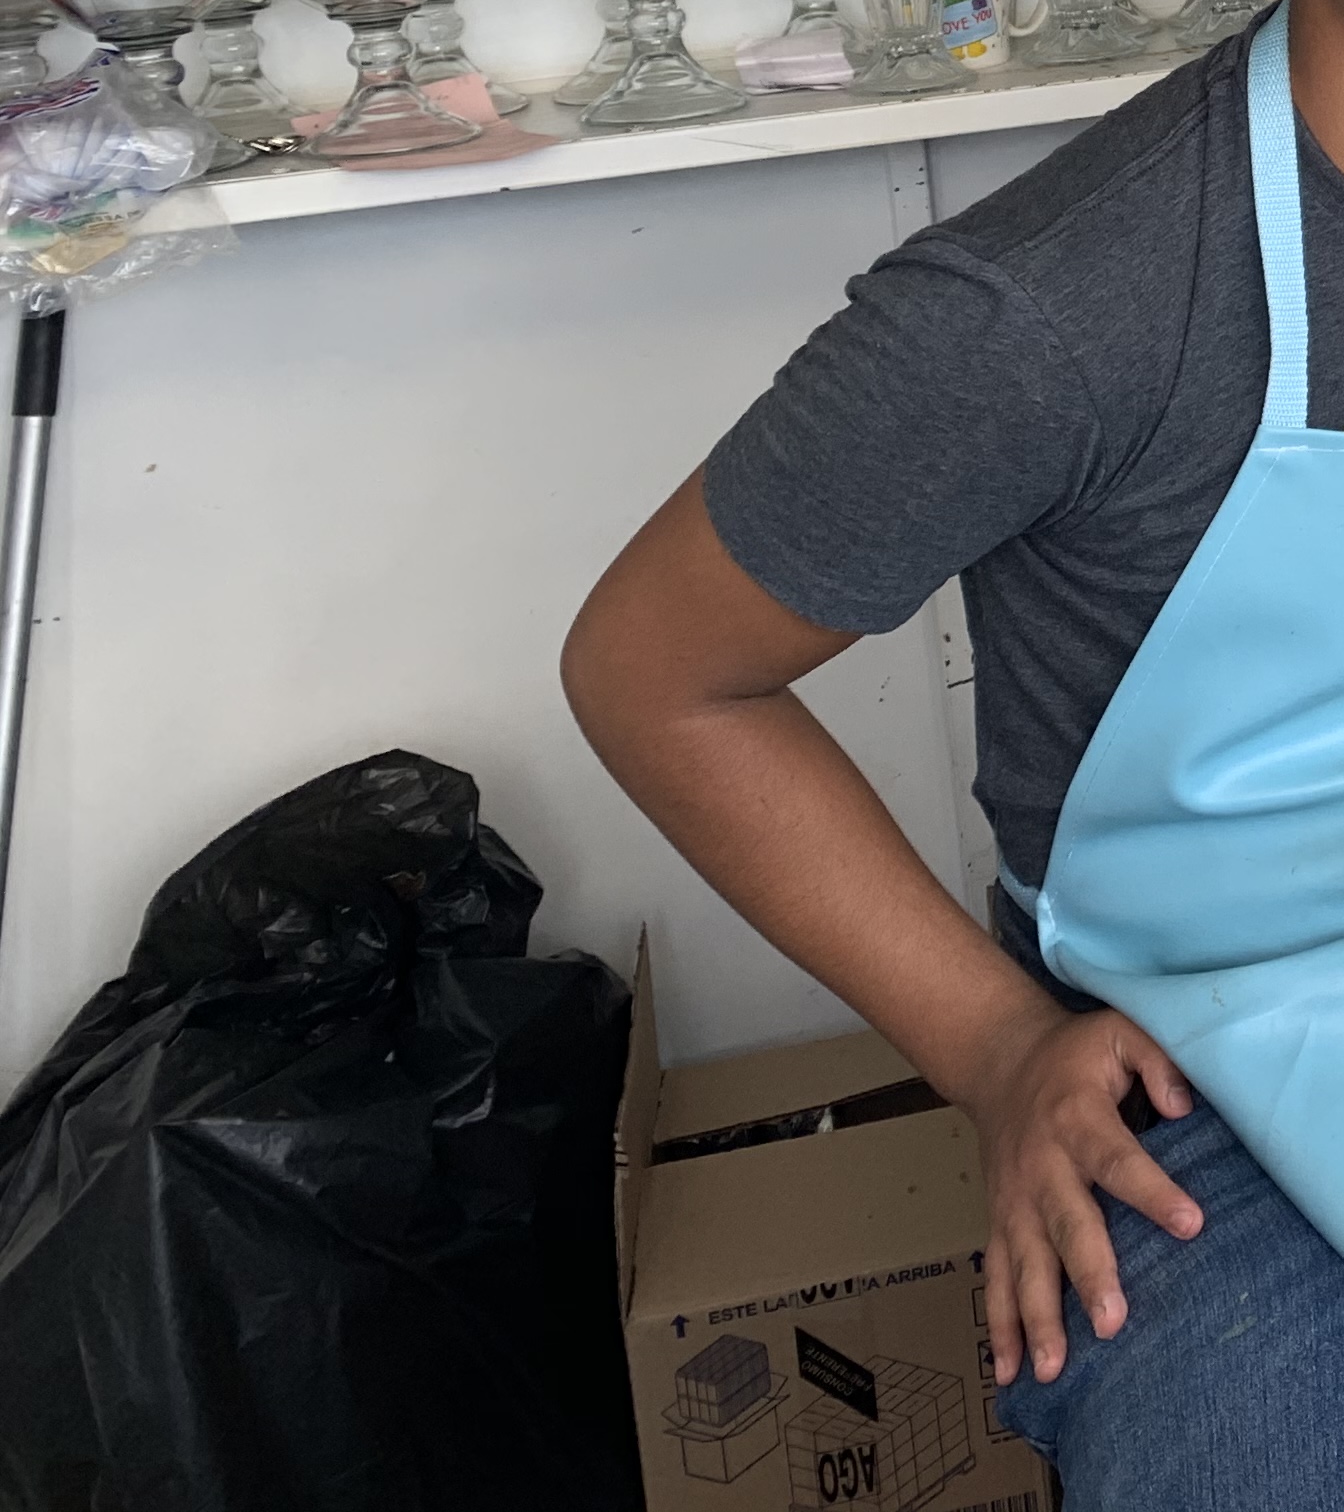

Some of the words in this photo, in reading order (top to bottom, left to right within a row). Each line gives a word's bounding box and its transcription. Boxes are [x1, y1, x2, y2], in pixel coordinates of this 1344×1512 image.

[971, 8, 992, 24] YOU
[708, 1303, 758, 1325] ESTE
[885, 1260, 957, 1287] ARRIBA
[818, 1443, 877, 1503] AGO
